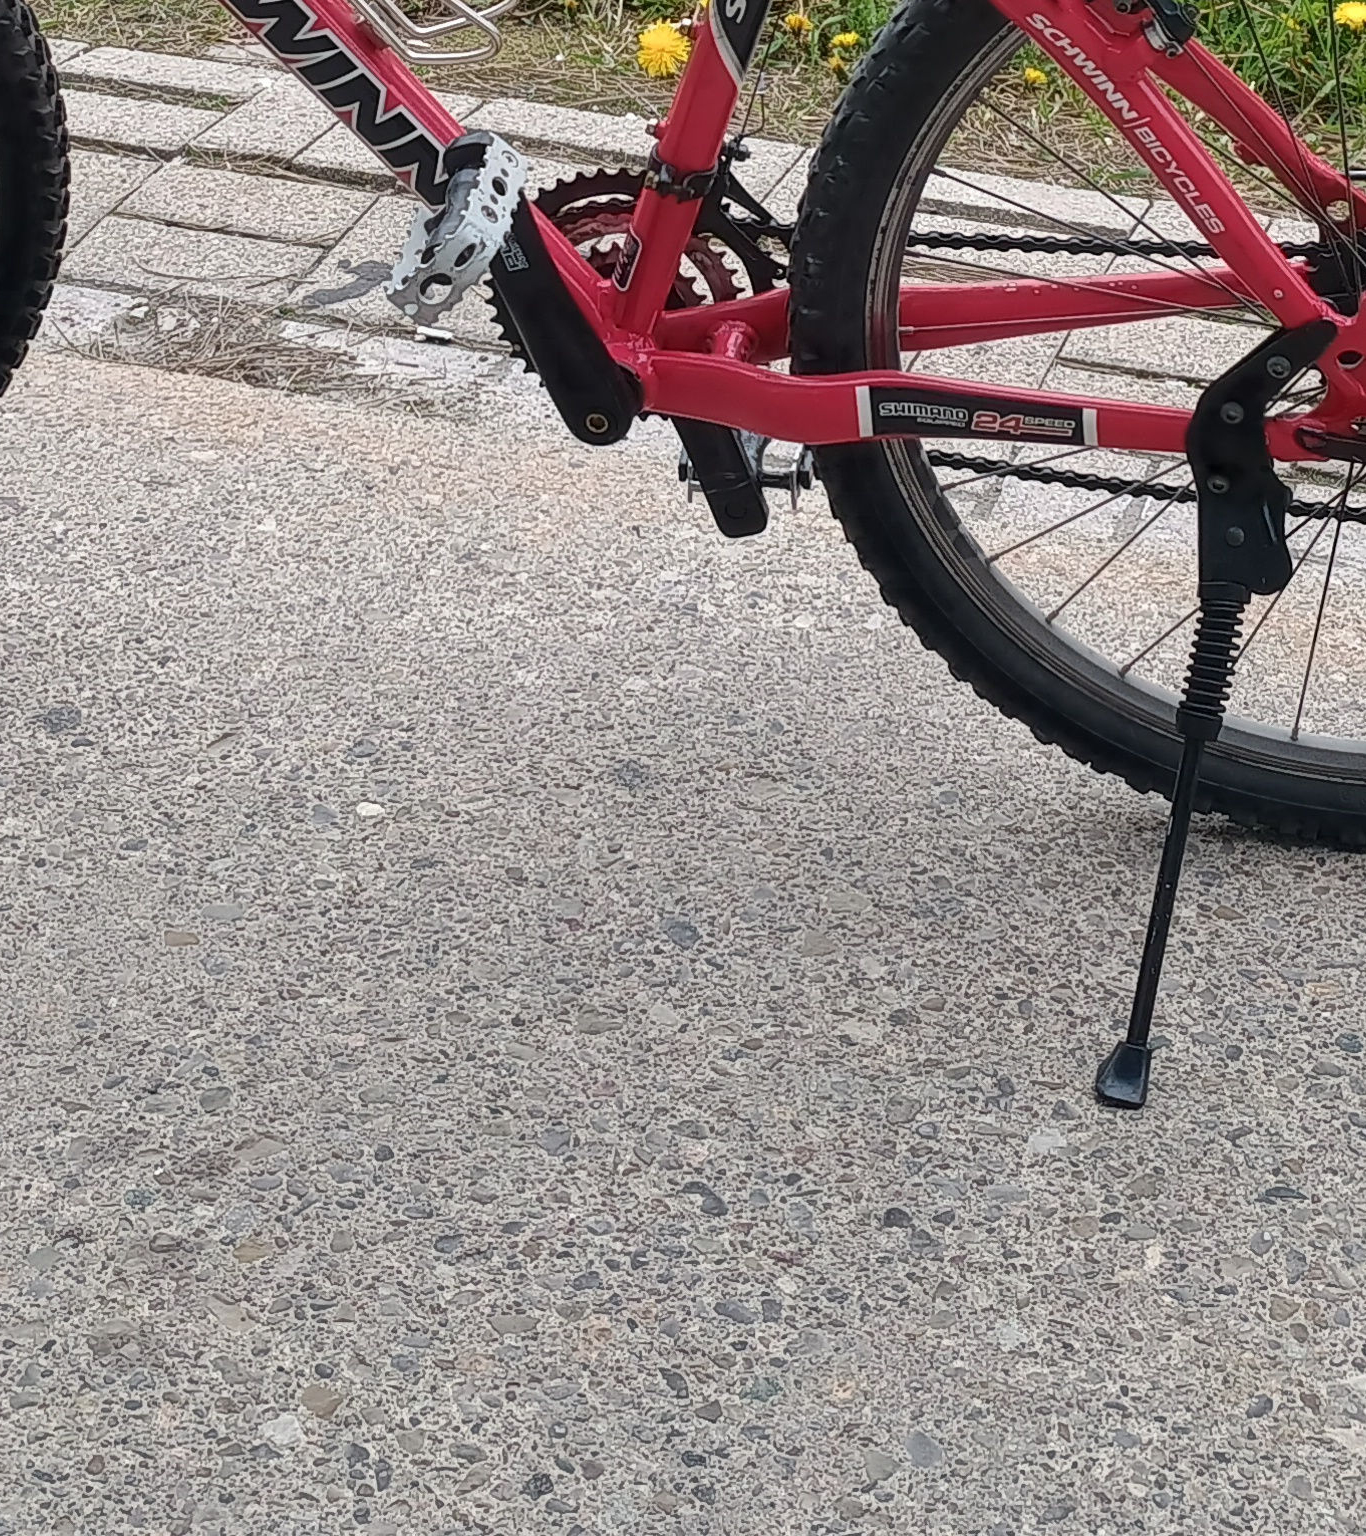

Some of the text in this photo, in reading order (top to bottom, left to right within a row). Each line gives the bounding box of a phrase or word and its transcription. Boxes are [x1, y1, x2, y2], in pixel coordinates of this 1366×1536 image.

[1026, 13, 1226, 234] SCHWINN BICYCLES
[878, 402, 1076, 435] SHIMANO 24 SPEED
